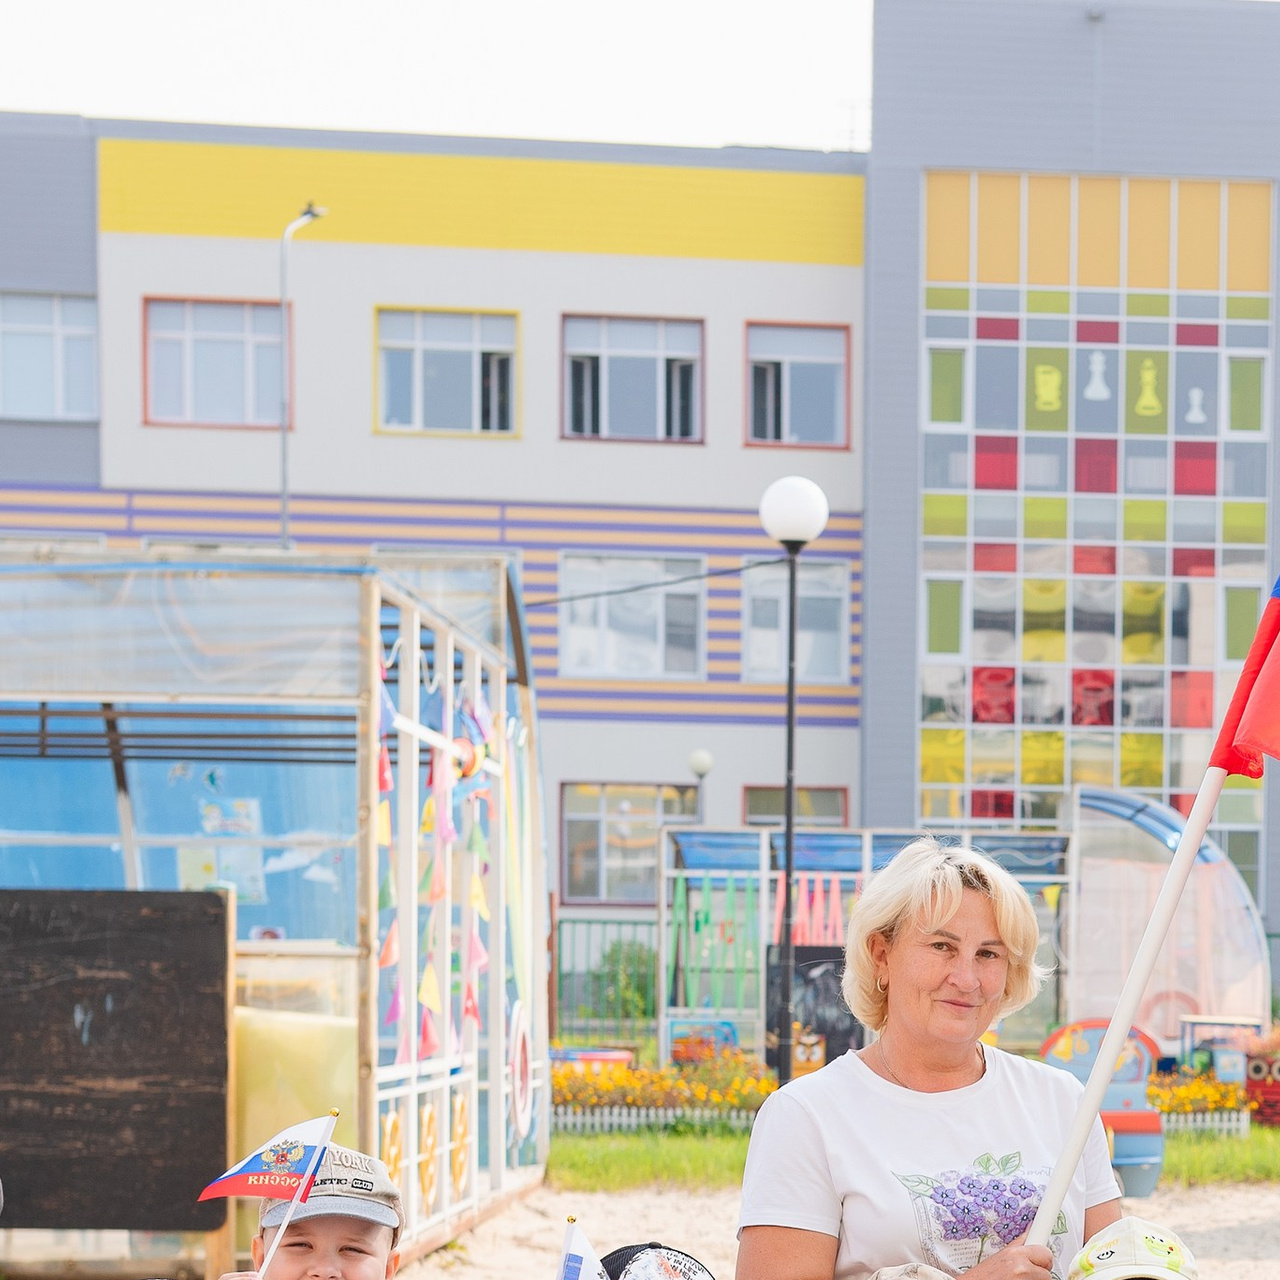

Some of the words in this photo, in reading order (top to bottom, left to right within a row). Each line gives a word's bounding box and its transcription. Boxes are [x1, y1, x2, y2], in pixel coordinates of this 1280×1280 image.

[333, 1149, 375, 1175] YORK
[314, 1178, 348, 1187] LETIC
[353, 1180, 373, 1190] CLUB
